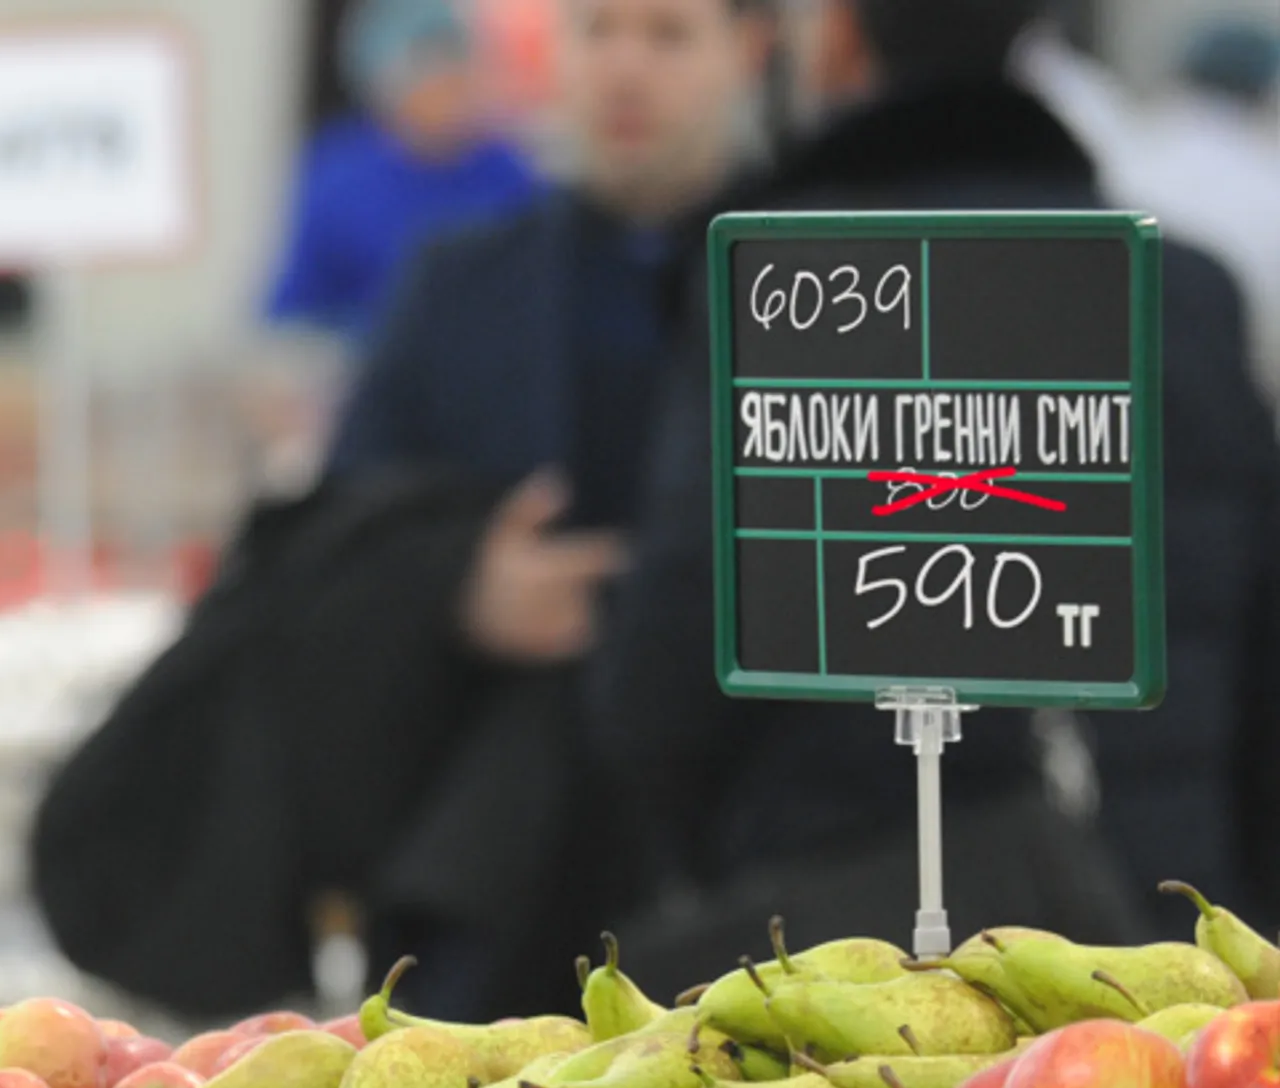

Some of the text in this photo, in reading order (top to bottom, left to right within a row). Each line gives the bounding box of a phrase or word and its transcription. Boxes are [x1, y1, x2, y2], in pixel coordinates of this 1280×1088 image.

[750, 263, 912, 334] 6039
[740, 389, 1132, 466] ЯБЛОКИ ГРЕННИ СМИТ
[854, 543, 1043, 630] 590
